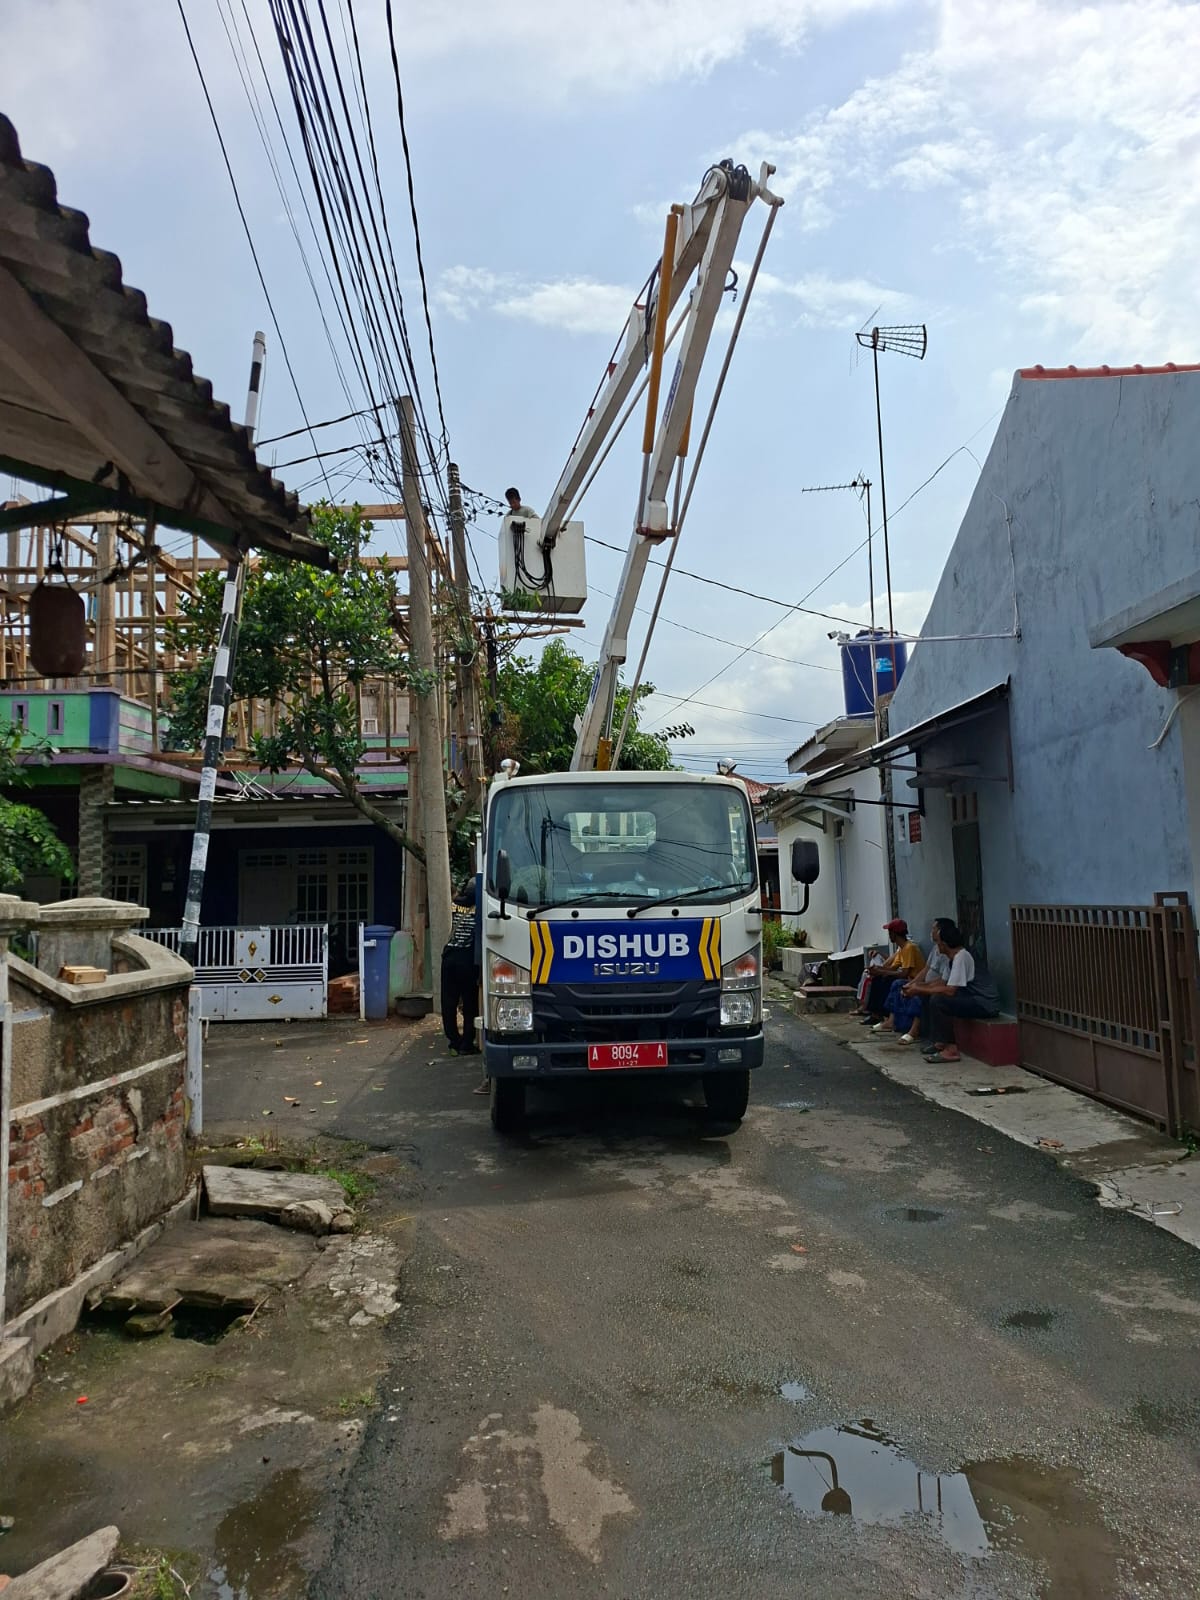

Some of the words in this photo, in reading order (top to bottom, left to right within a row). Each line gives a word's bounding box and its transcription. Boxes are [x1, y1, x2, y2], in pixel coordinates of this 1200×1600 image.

[563, 933, 690, 959] DISHUB
[593, 962, 660, 976] ISUZU
[592, 1046, 599, 1061] A
[611, 1045, 639, 1060] 8094
[657, 1044, 663, 1059] A
